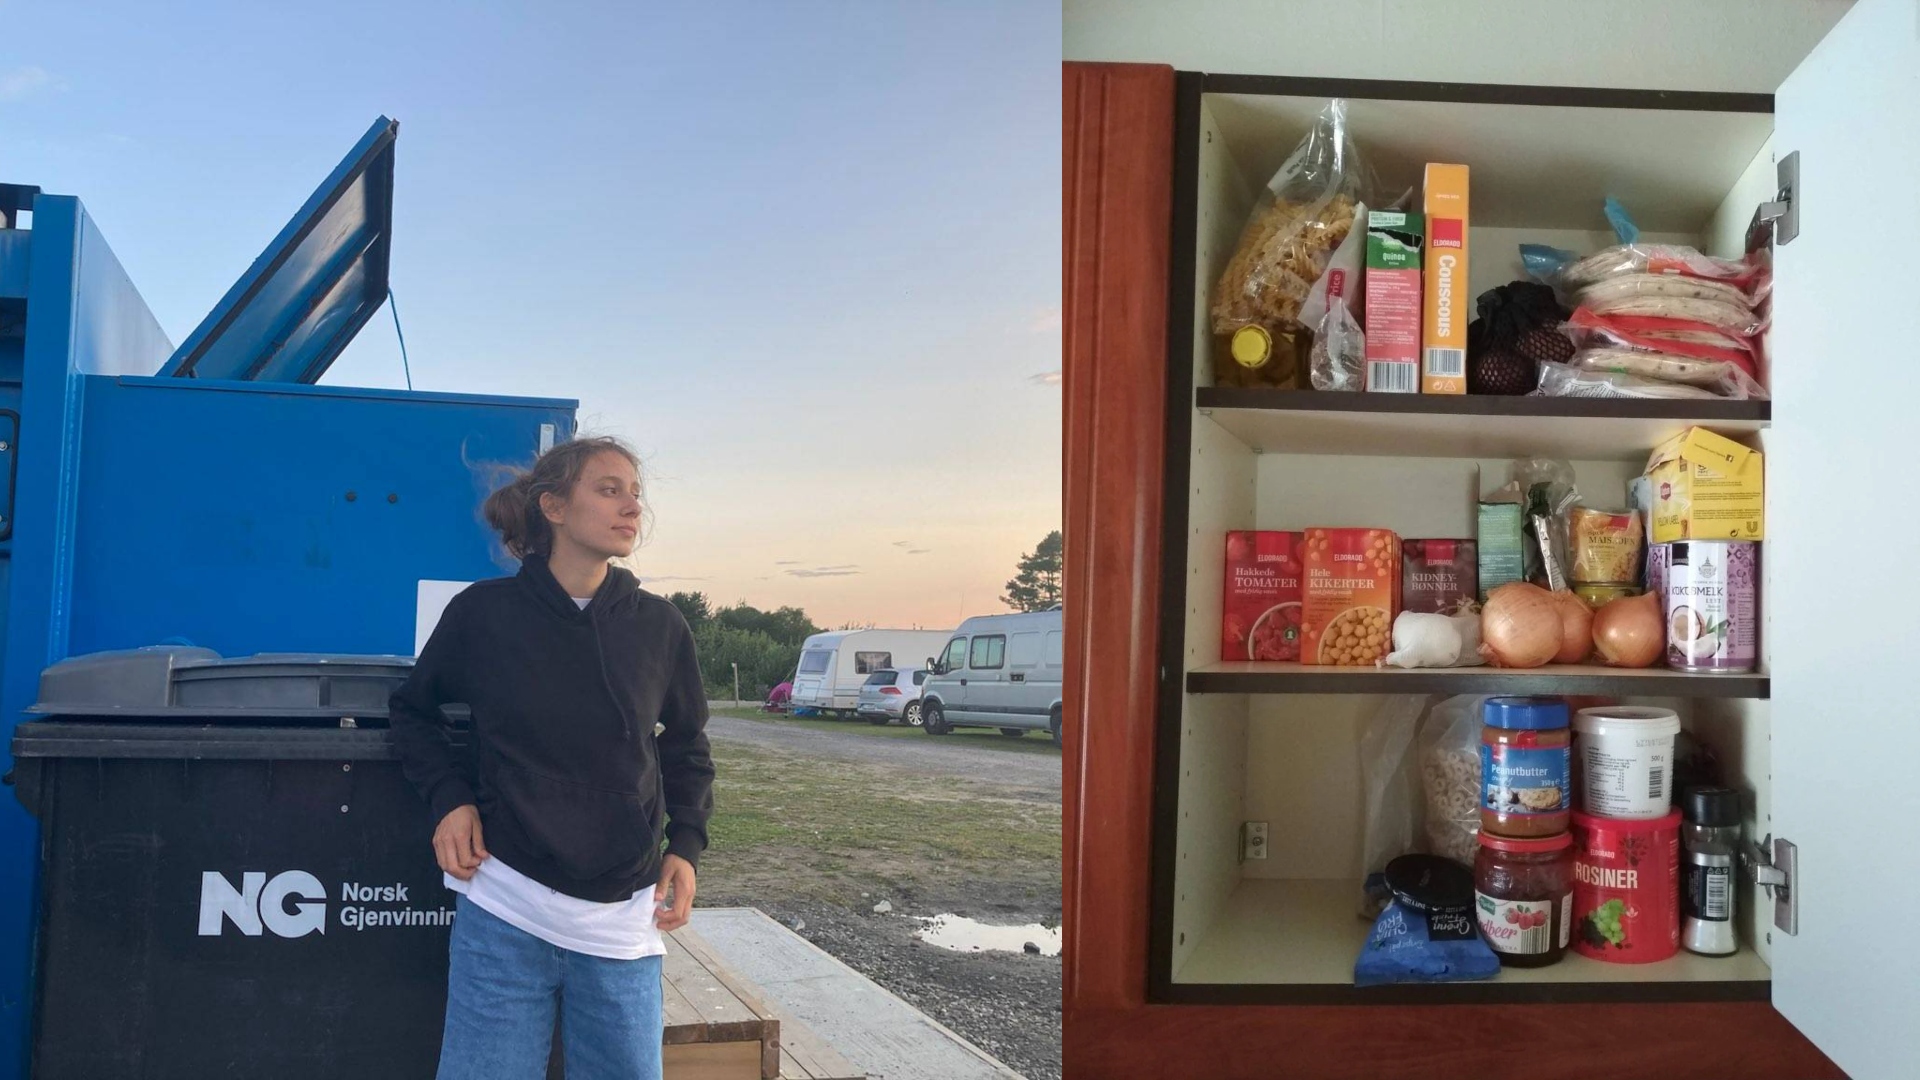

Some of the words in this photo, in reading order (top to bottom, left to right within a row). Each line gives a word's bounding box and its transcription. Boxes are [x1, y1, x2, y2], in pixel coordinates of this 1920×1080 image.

[1433, 239, 1461, 248] ELDORADO
[1438, 254, 1457, 338] Couscous
[1257, 554, 1288, 562] ELDORADO
[1334, 554, 1363, 562] ELDORADO
[1235, 567, 1276, 576] Hakkede
[1310, 569, 1331, 577] Hele
[1234, 577, 1298, 588] TOMATER
[1412, 573, 1457, 582] KIDNEY-
[1309, 579, 1375, 589] KIKERTER
[1411, 582, 1458, 591] BØNNER
[1491, 764, 1549, 777] Peanutbutter
[1590, 849, 1615, 858] ELDORADO
[1575, 862, 1638, 889] ROSINER
[342, 882, 409, 902] Norsk
[198, 869, 328, 939] NG
[340, 907, 456, 931] Gjenvinnin
[1432, 917, 1471, 935] Grønn
